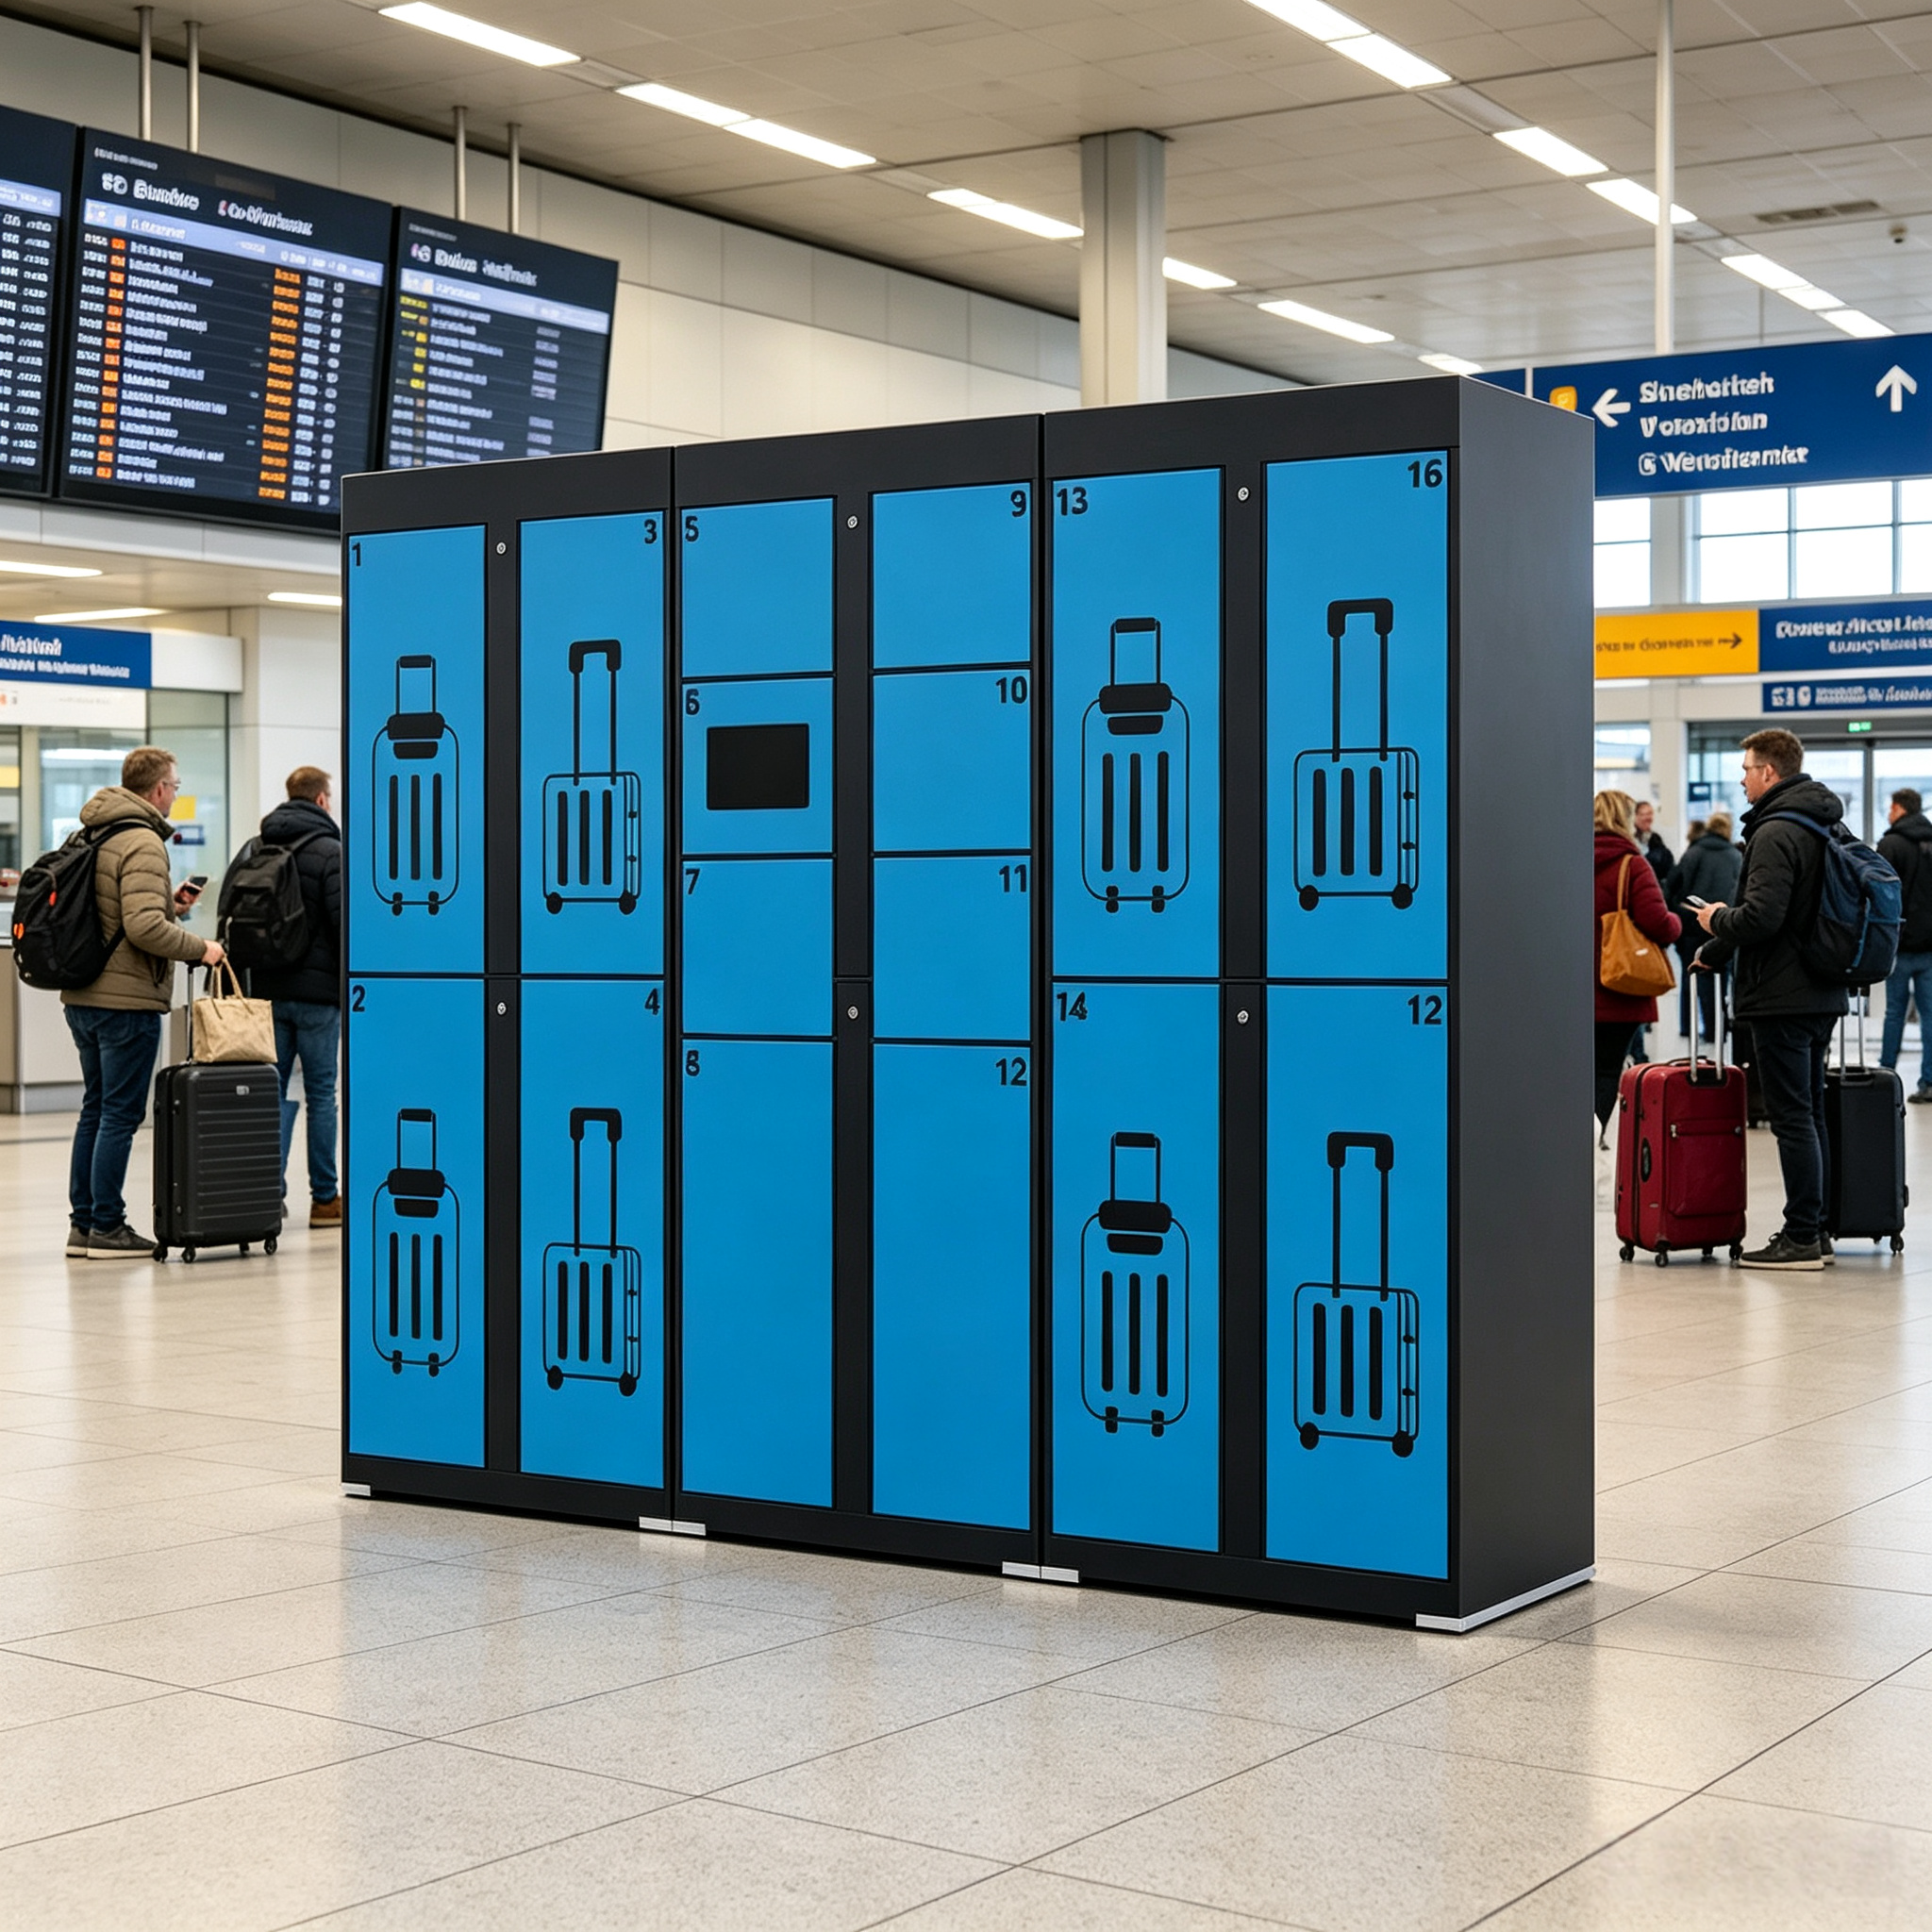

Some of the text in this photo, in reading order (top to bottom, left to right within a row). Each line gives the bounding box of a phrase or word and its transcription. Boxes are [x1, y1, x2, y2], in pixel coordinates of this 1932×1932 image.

[1407, 458, 1443, 488] 16
[1010, 490, 1027, 518] 9
[1057, 486, 1089, 516] 13
[644, 519, 658, 544] 3
[685, 515, 699, 542] 5
[352, 542, 361, 567] 1
[685, 689, 700, 716] 6
[995, 675, 1028, 705] 10
[685, 868, 700, 895] 7
[999, 864, 1027, 892] 11
[352, 985, 366, 1012] 2
[644, 988, 660, 1016] 4
[1056, 991, 1088, 1022] 14
[1407, 994, 1442, 1025] 12
[995, 1057, 1027, 1087] 12
